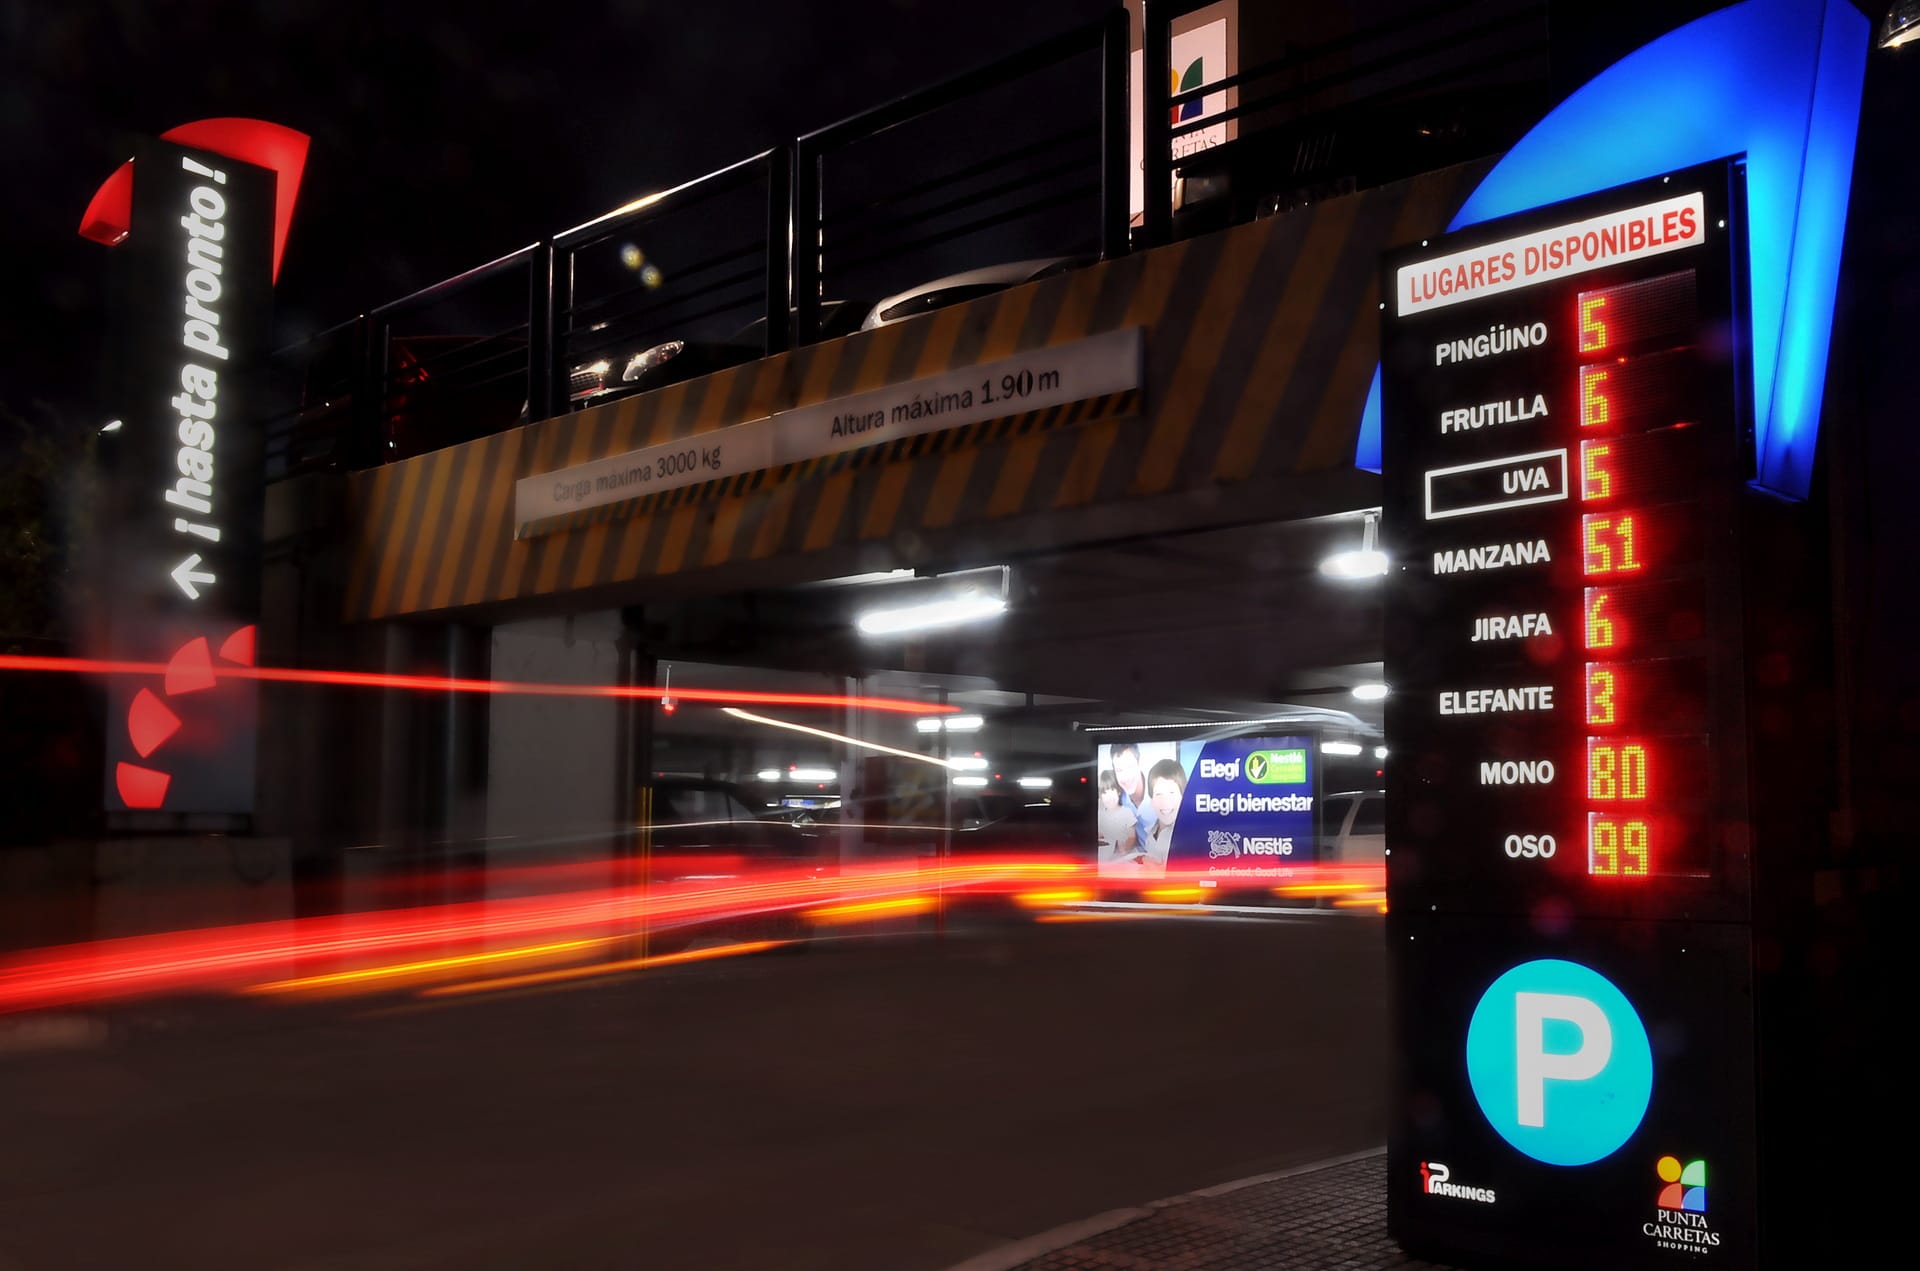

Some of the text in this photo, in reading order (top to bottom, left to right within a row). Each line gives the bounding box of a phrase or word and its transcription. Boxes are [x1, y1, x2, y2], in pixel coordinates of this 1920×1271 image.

[1410, 207, 1697, 304] LUGARES DISPONIBLES
[1435, 323, 1548, 366] PINGÜINO
[1582, 297, 1608, 353] 5
[830, 369, 1060, 439] Altura máxima 1.90 m
[1440, 394, 1549, 434] FRUTILLA
[1584, 371, 1609, 426] 6
[552, 478, 592, 502] Carga
[656, 449, 697, 479] 3000
[702, 445, 722, 471] kg
[1502, 466, 1550, 494] UVA
[1585, 446, 1611, 500] 5
[1433, 540, 1551, 575] MANZANA
[1587, 517, 1641, 575] 51
[1471, 612, 1553, 642] JIRAFA
[1588, 594, 1614, 649] 6
[1439, 686, 1554, 715] ELEFANTE
[1590, 671, 1616, 725] 3
[1200, 758, 1240, 781] Elegí
[1480, 760, 1555, 785] MONO
[1591, 745, 1647, 800] 80
[1195, 793, 1313, 816] Elegí bienestar
[1504, 834, 1556, 859] OSO
[1593, 821, 1649, 876] 99
[1515, 991, 1613, 1129] P
[1642, 1222, 1720, 1246] CARRETAS
[1657, 1209, 1708, 1229] PUNTA
[1656, 1240, 1708, 1254] SHOPPING
